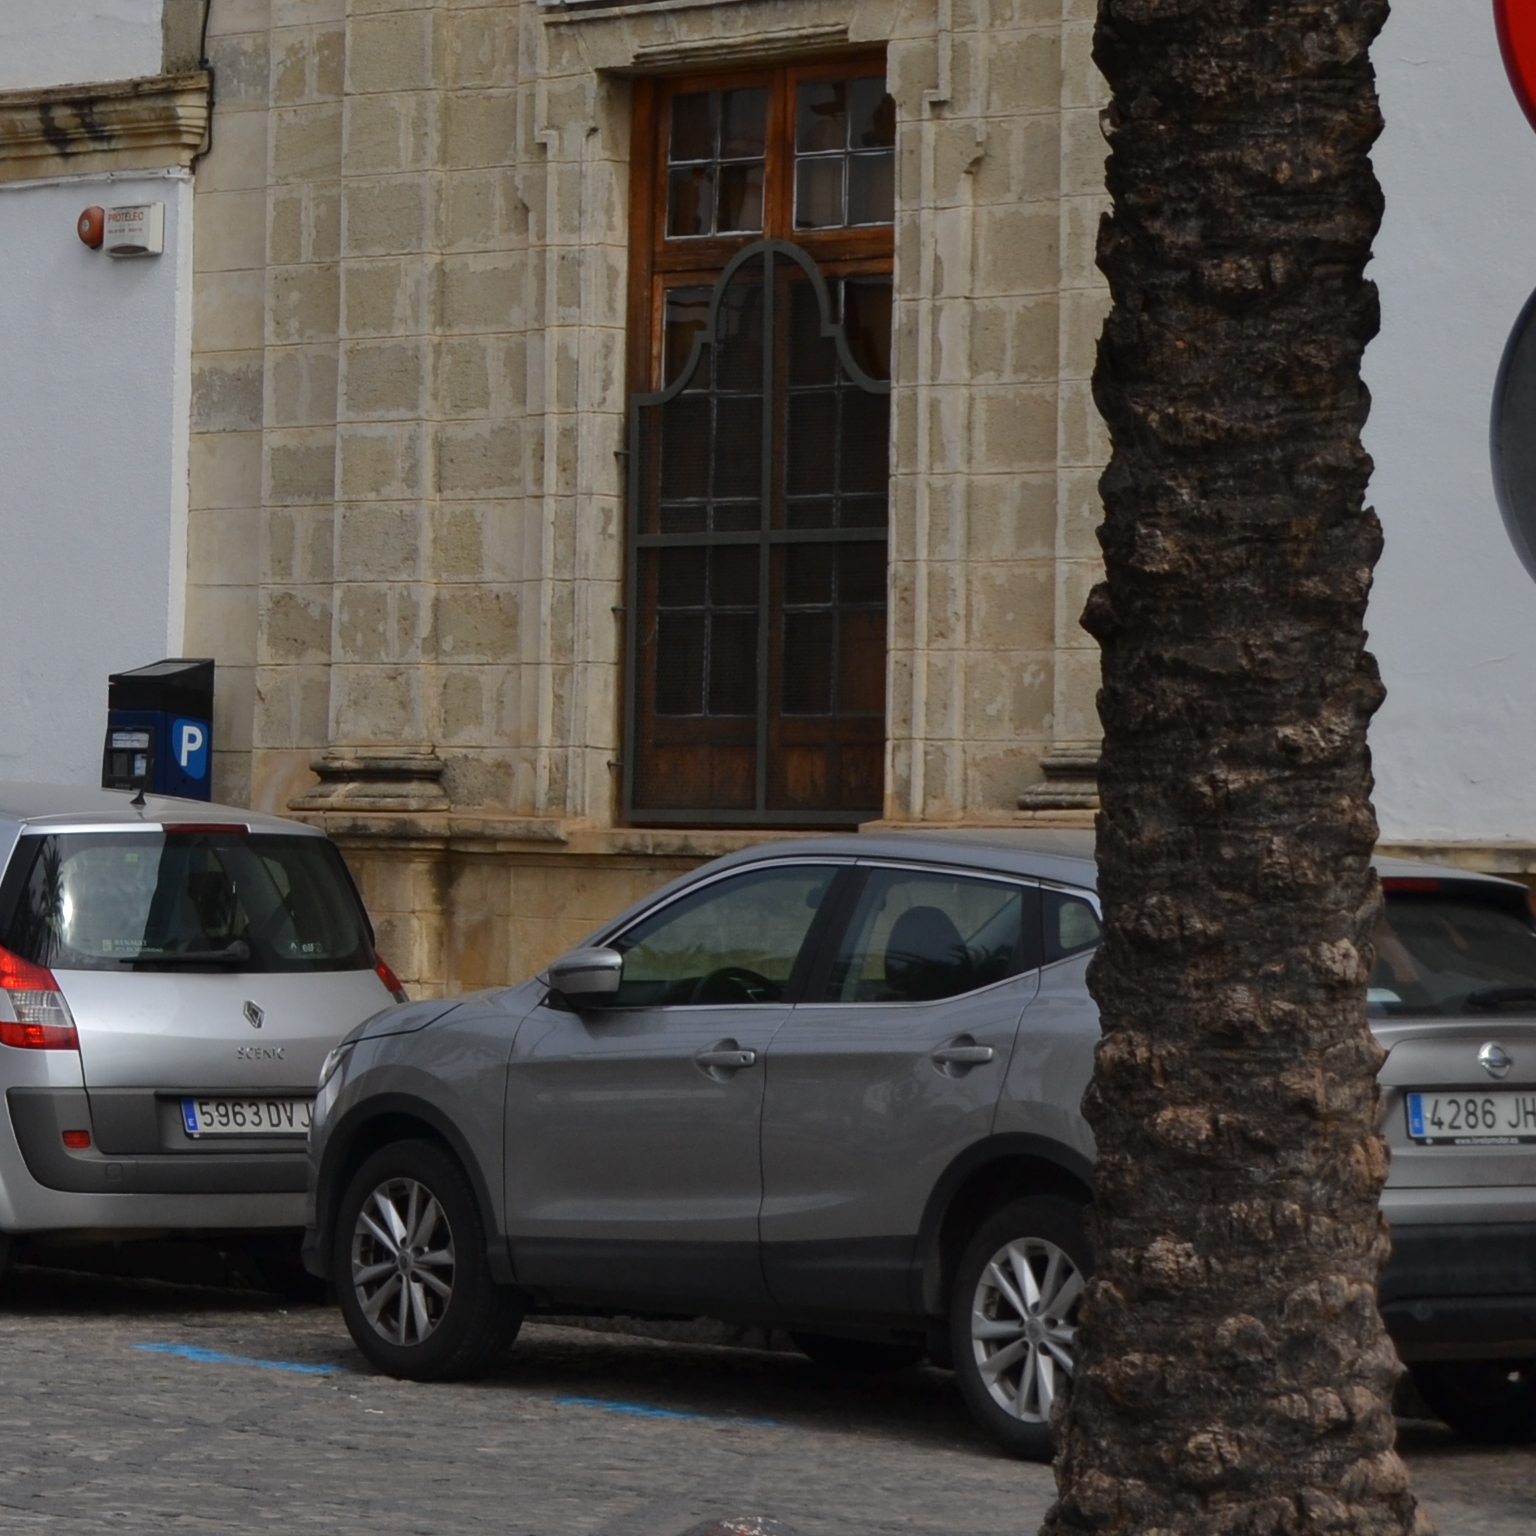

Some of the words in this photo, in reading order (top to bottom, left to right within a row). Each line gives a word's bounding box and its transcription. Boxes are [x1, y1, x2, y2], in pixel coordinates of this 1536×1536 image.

[180, 725, 203, 767] P
[237, 1047, 286, 1060] SCENIC
[198, 1102, 263, 1127] 5963
[1430, 1098, 1496, 1130] 4286
